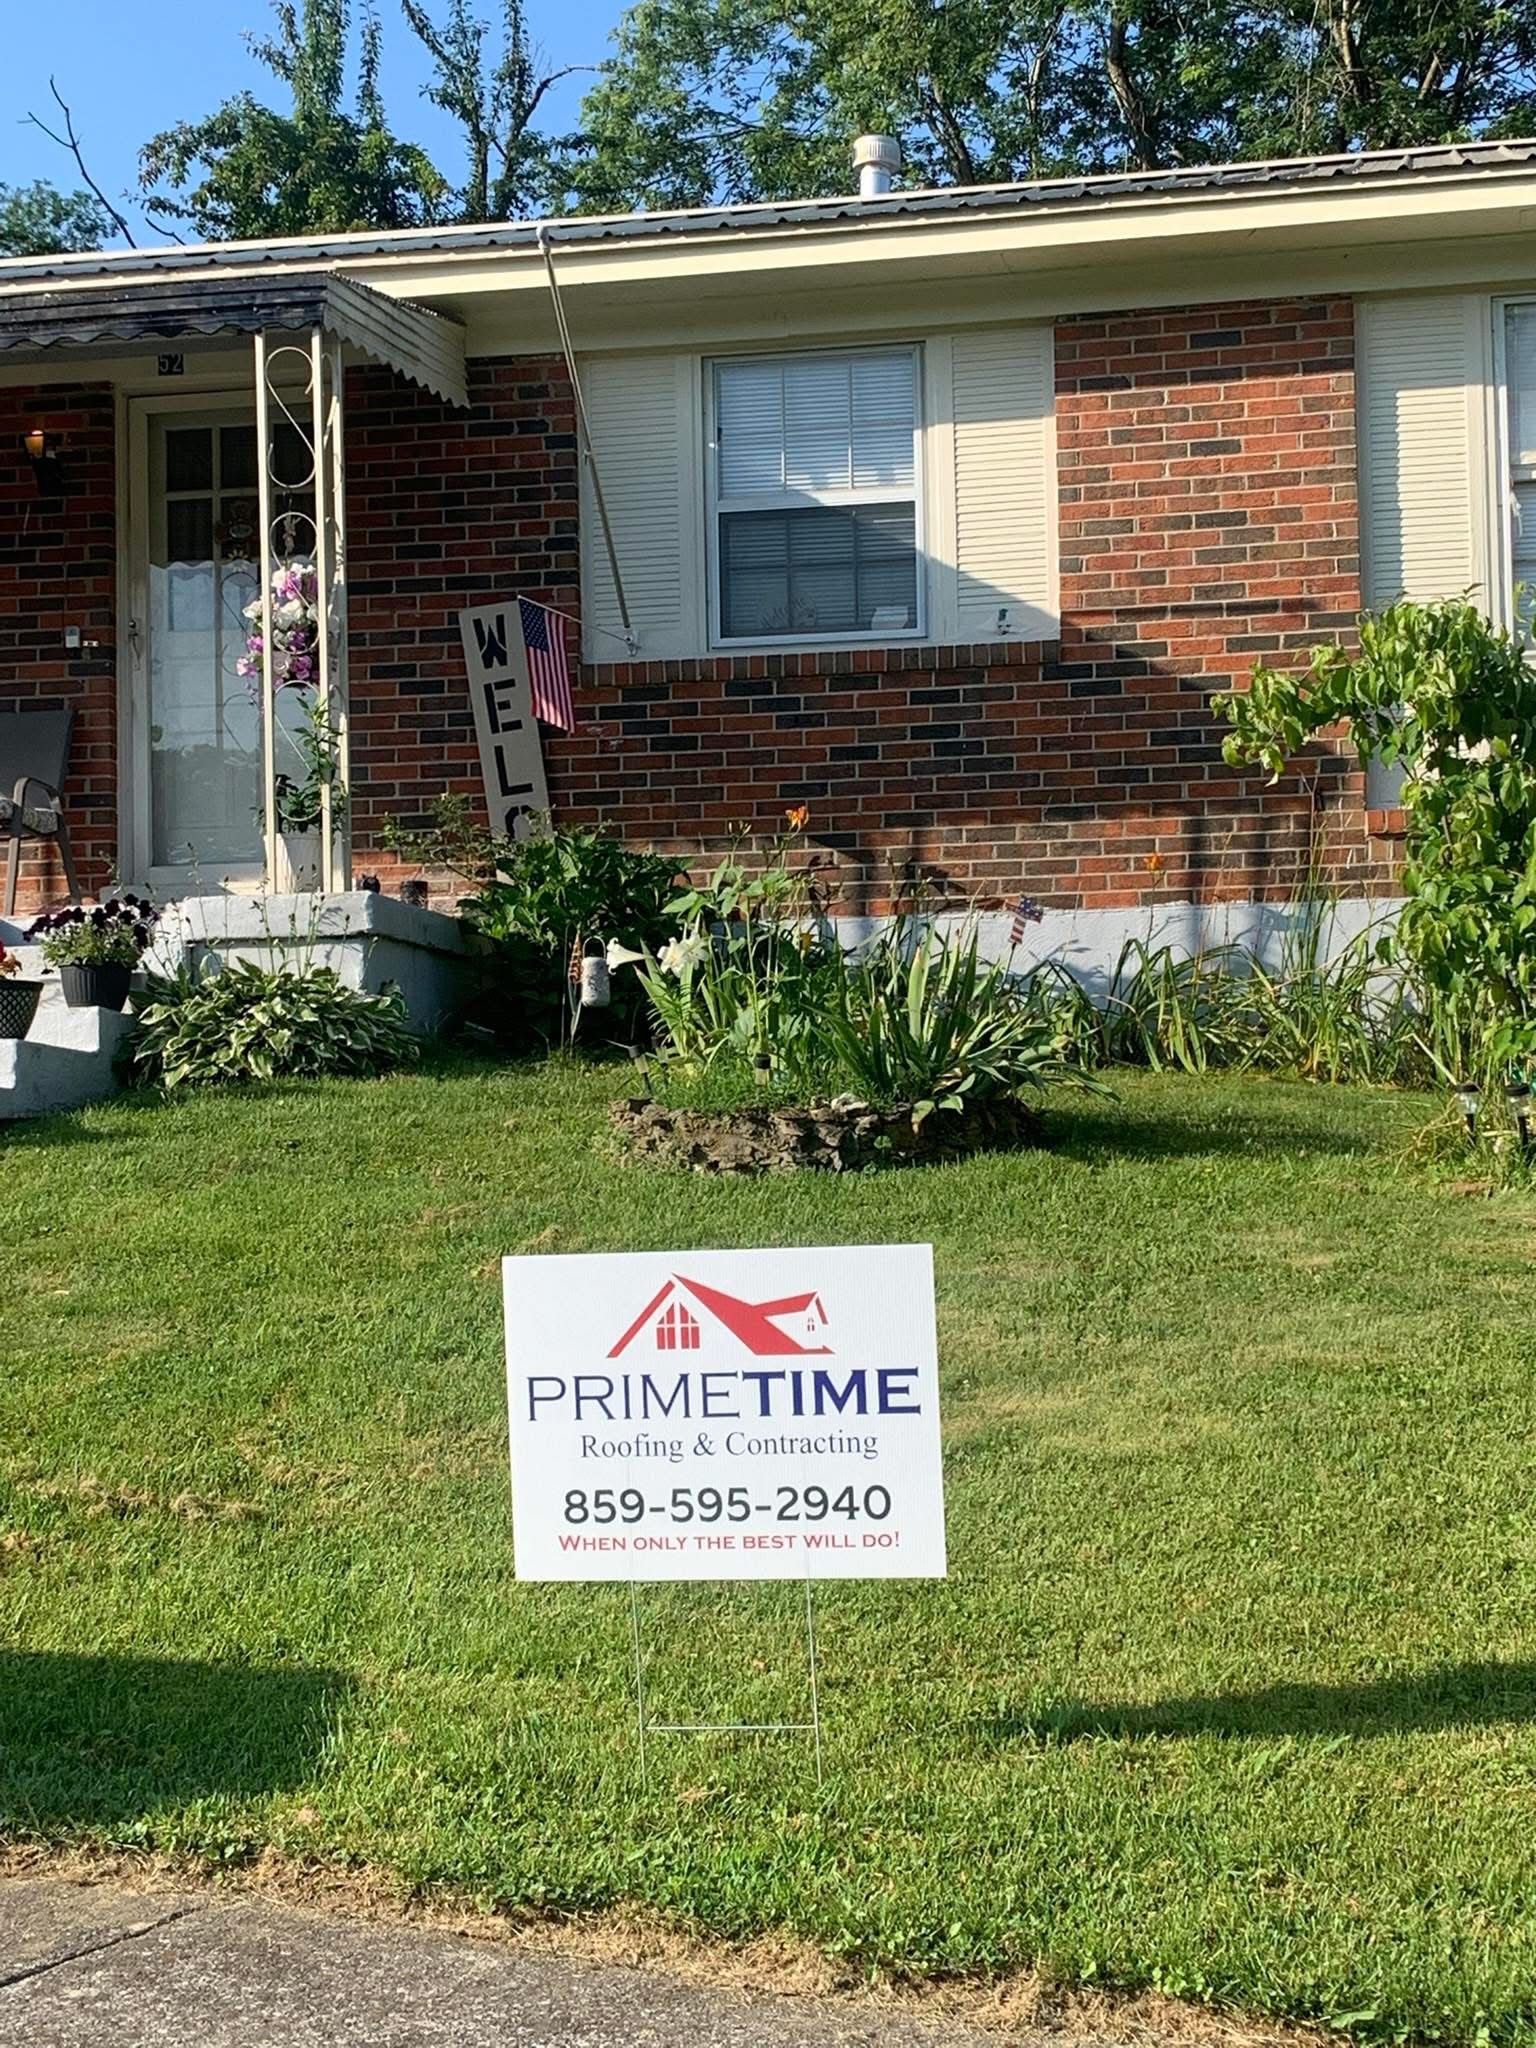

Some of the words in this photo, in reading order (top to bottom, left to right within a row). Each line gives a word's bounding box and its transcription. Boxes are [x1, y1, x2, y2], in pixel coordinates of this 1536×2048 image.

[160, 353, 182, 372] 52
[527, 1366, 921, 1421] PRIMETIME
[581, 1433, 684, 1463] Roofing
[693, 1433, 716, 1457] &
[726, 1429, 878, 1460] Contracting
[564, 1485, 891, 1524] 859-595-2940
[633, 1537, 686, 1550] ONLY
[694, 1536, 735, 1549] THE
[743, 1535, 797, 1549] BEST
[803, 1535, 856, 1548] WILL
